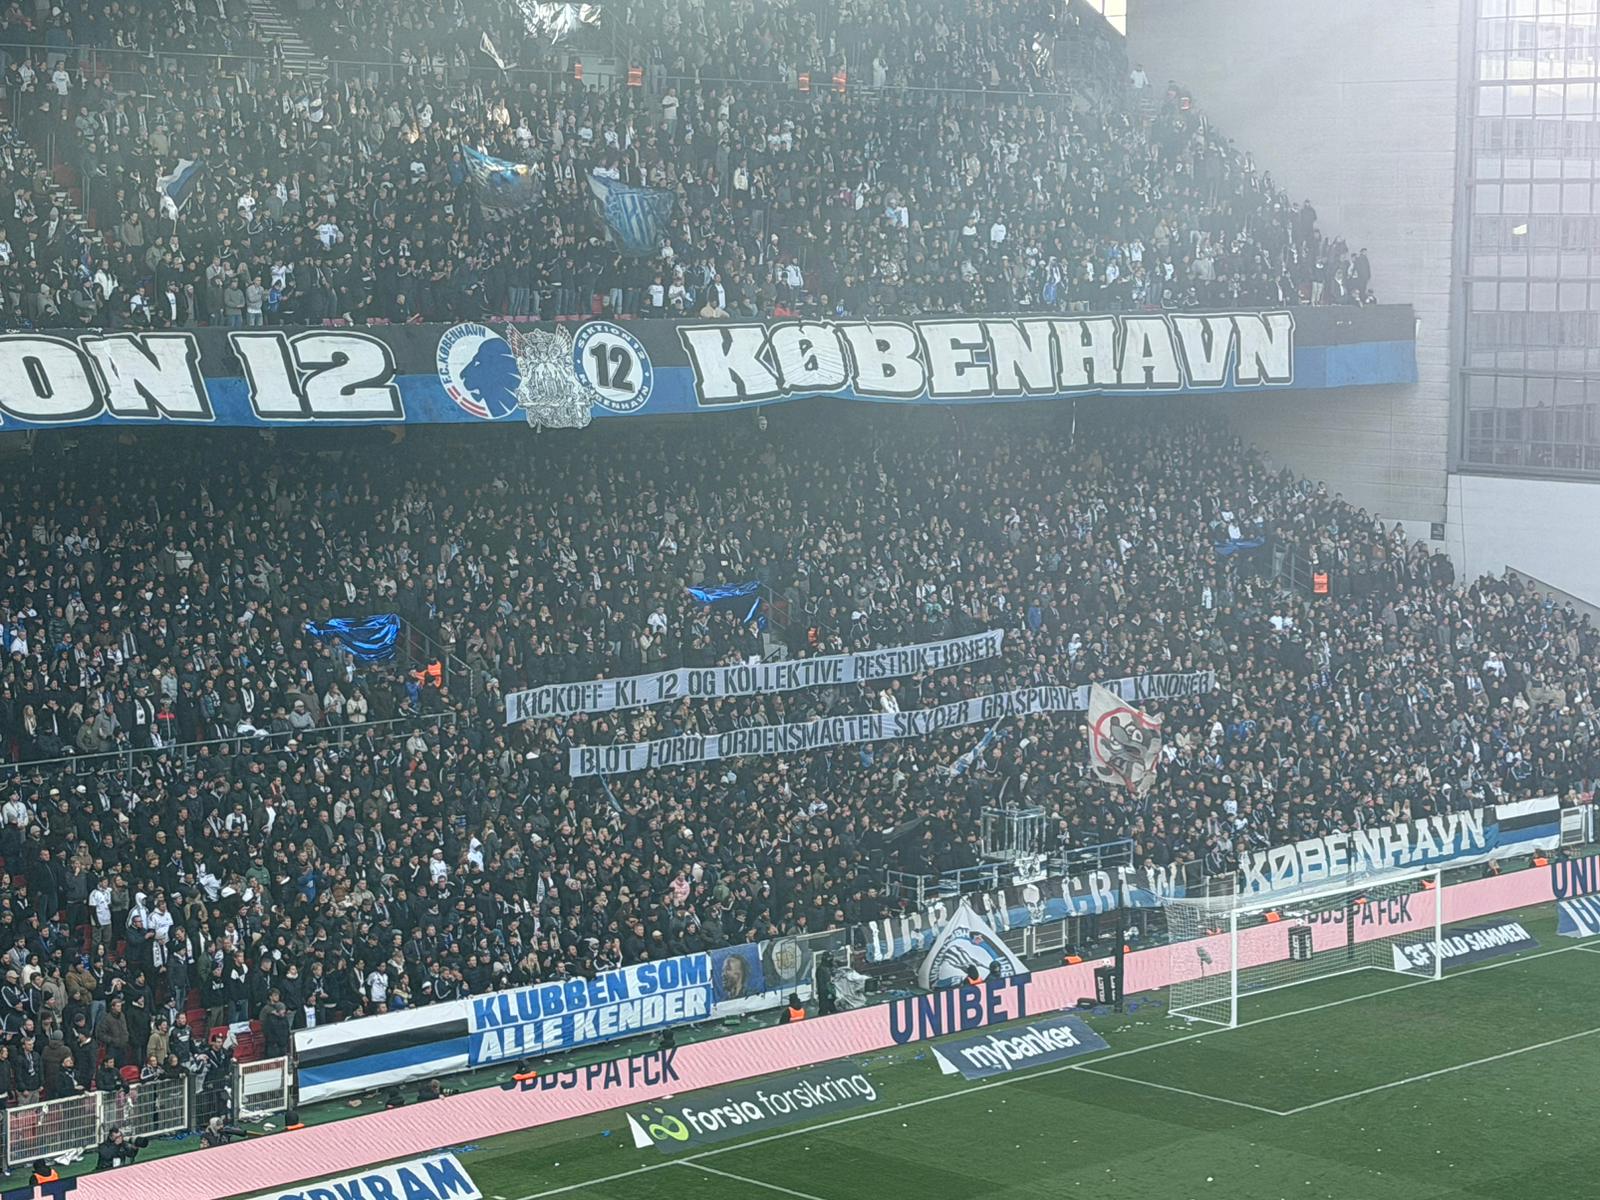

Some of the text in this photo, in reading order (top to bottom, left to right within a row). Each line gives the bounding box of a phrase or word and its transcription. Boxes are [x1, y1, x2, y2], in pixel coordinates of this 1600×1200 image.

[229, 332, 404, 420] 12
[589, 341, 635, 393] 12
[678, 311, 1295, 406] KØBENHAVN
[515, 683, 604, 719] KICKOFF
[655, 672, 679, 699] 12
[687, 669, 716, 696] OG
[723, 658, 845, 694] KOLLEKTIVE
[852, 636, 997, 681] RESTRIKTIONER
[1133, 673, 1210, 700] KANONER
[579, 745, 637, 775] BLOT
[647, 736, 706, 766] FORDI
[717, 714, 884, 757] ORDENSMAGTEN
[893, 700, 970, 737] SKYDER
[1240, 808, 1486, 895] KØBENHAVN
[1377, 894, 1413, 926] FCK
[1404, 922, 1531, 966] 3F HOLD SAMMEN
[473, 954, 708, 1029] KLUBBEN SOM
[477, 987, 707, 1063] ALLE KENDER
[889, 974, 1032, 1045] UNIBET
[628, 1048, 679, 1088] FCK
[960, 1026, 1081, 1070] mybanker
[682, 1074, 876, 1134] forsia forsikring
